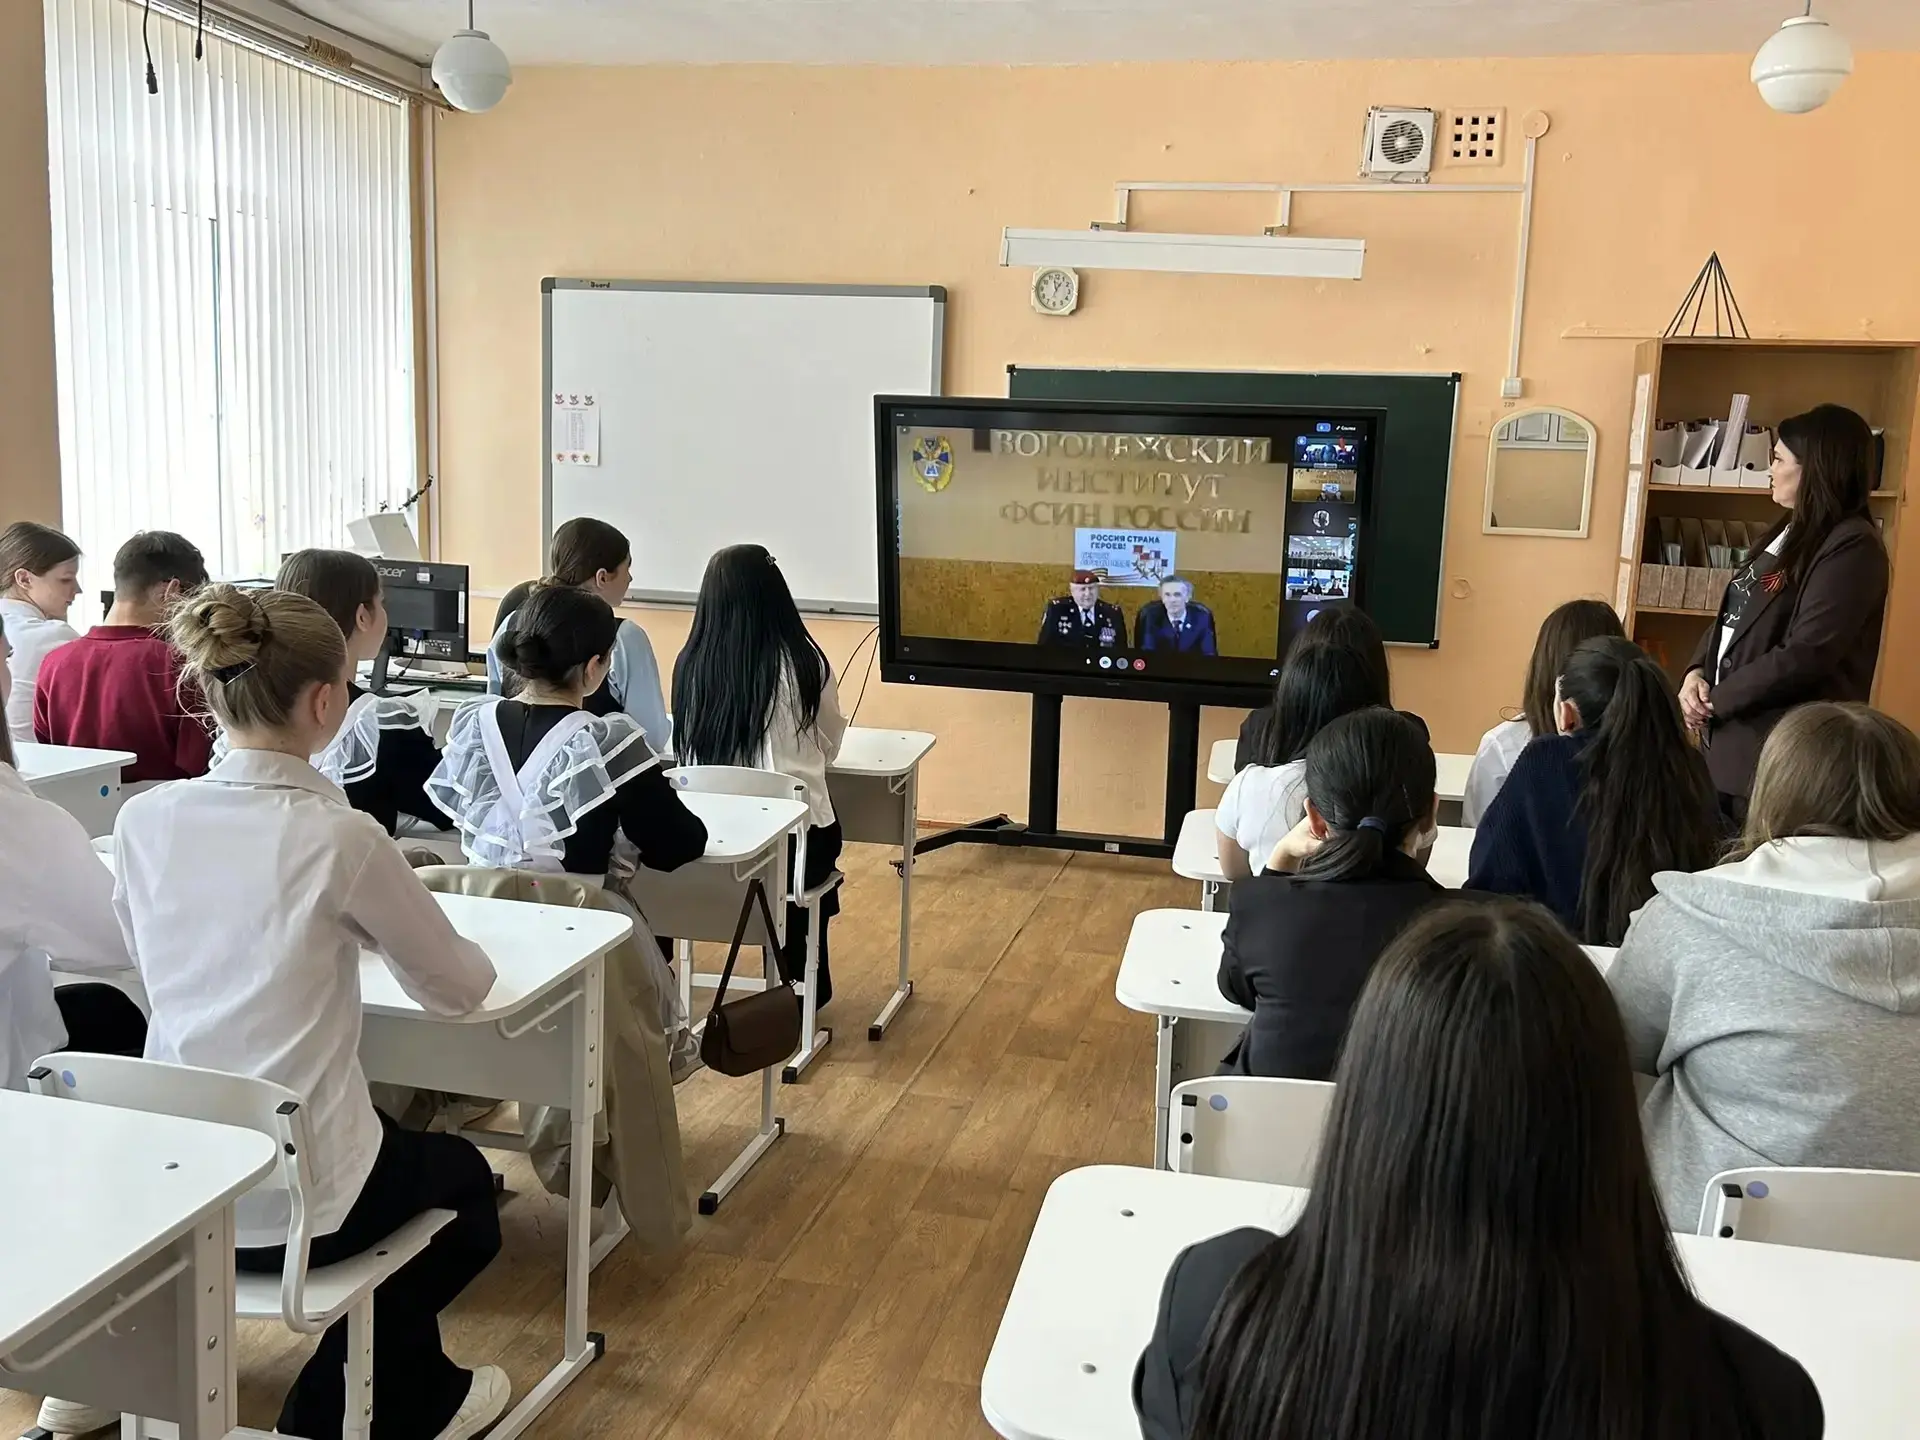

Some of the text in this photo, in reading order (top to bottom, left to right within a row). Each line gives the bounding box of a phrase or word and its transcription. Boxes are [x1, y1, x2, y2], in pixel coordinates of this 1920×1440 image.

[1037, 466, 1227, 503] ИНСТИТУТ
[1000, 501, 1253, 535] ФСИН РОССИИ
[1090, 534, 1160, 543] РОССИЯ СТРАНА
[1090, 542, 1126, 550] ГЕРОЕВ!
[379, 567, 406, 577] acer
